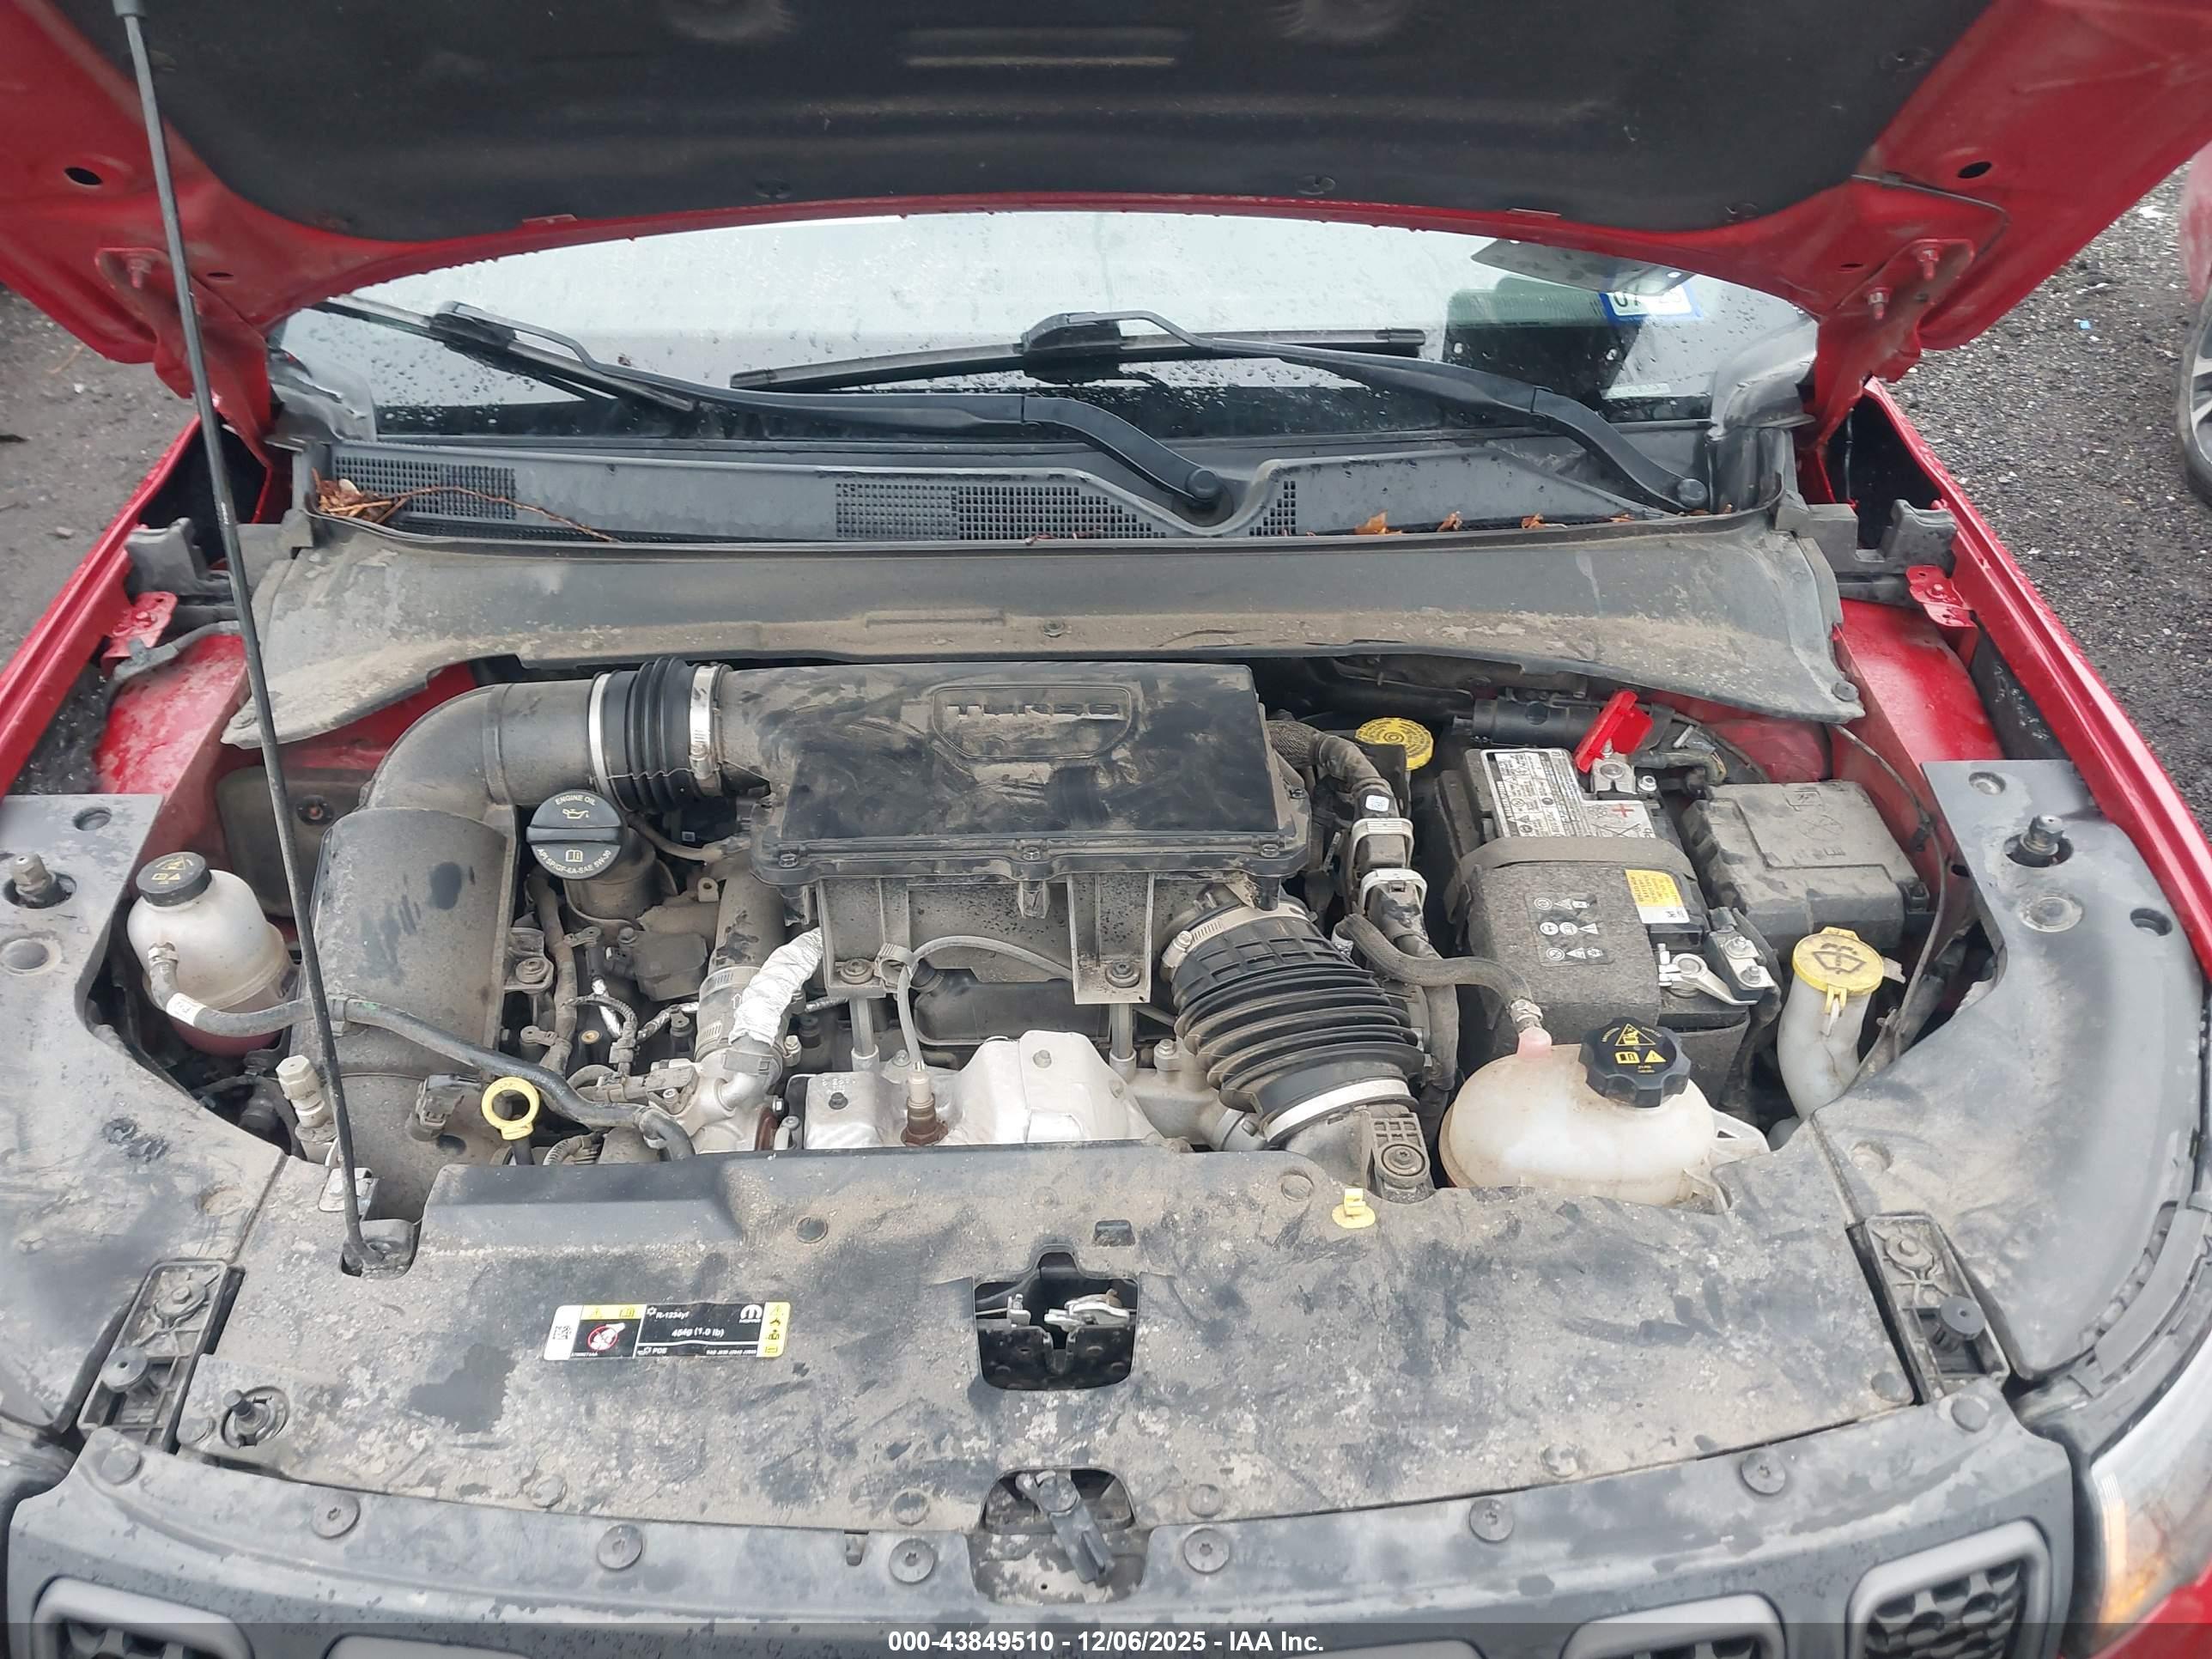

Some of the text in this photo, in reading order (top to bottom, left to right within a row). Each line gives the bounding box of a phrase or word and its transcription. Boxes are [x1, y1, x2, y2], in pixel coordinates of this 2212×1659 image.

[555, 794, 597, 806] ENGINE OIL
[537, 848, 548, 860] API
[593, 849, 611, 868] 5W-30
[656, 1310, 690, 1320] R-1234yf
[672, 1327, 725, 1338] 454g (1.0 lb)
